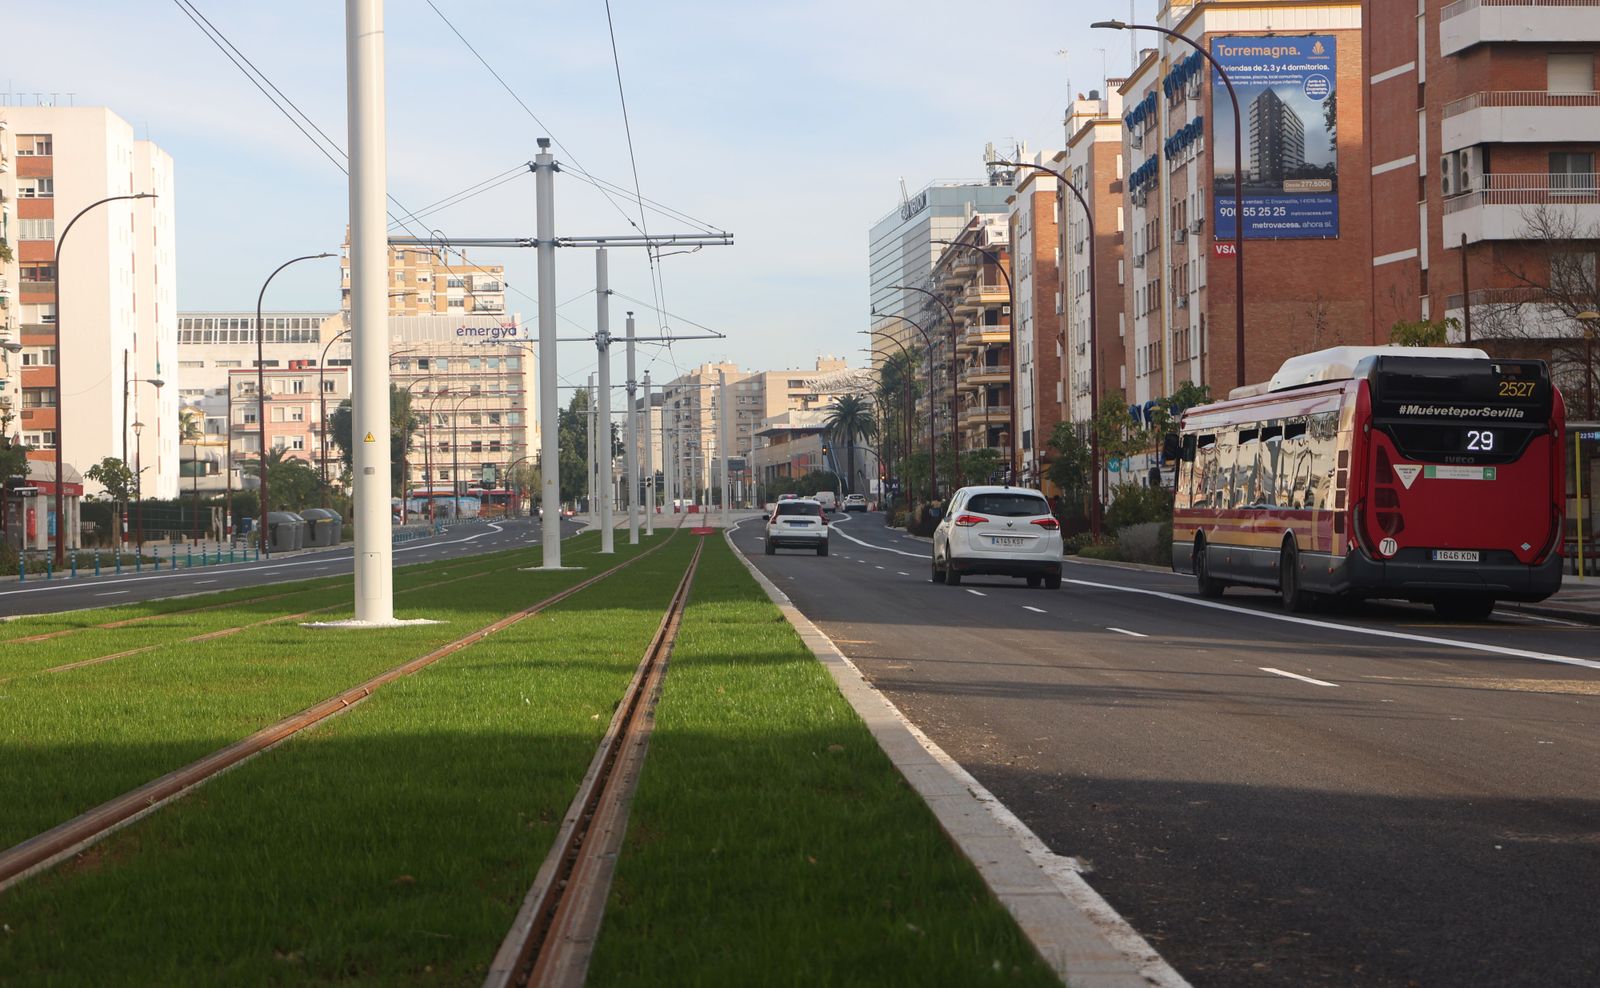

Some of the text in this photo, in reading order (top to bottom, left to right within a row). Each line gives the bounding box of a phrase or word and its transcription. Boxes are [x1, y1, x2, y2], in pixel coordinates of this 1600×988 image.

[1217, 45, 1301, 58] Torremagna.
[1263, 64, 1270, 72] 2,
[1243, 207, 1256, 216] 55
[1258, 207, 1271, 216] 25
[1273, 206, 1286, 216] 25
[456, 326, 516, 338] emergya
[1499, 382, 1536, 396] 2527
[1399, 405, 1524, 418] #MuéveteporSevilla
[1467, 430, 1493, 450] 29
[1383, 540, 1395, 554] 70
[1439, 551, 1477, 560] 1646 KDN
